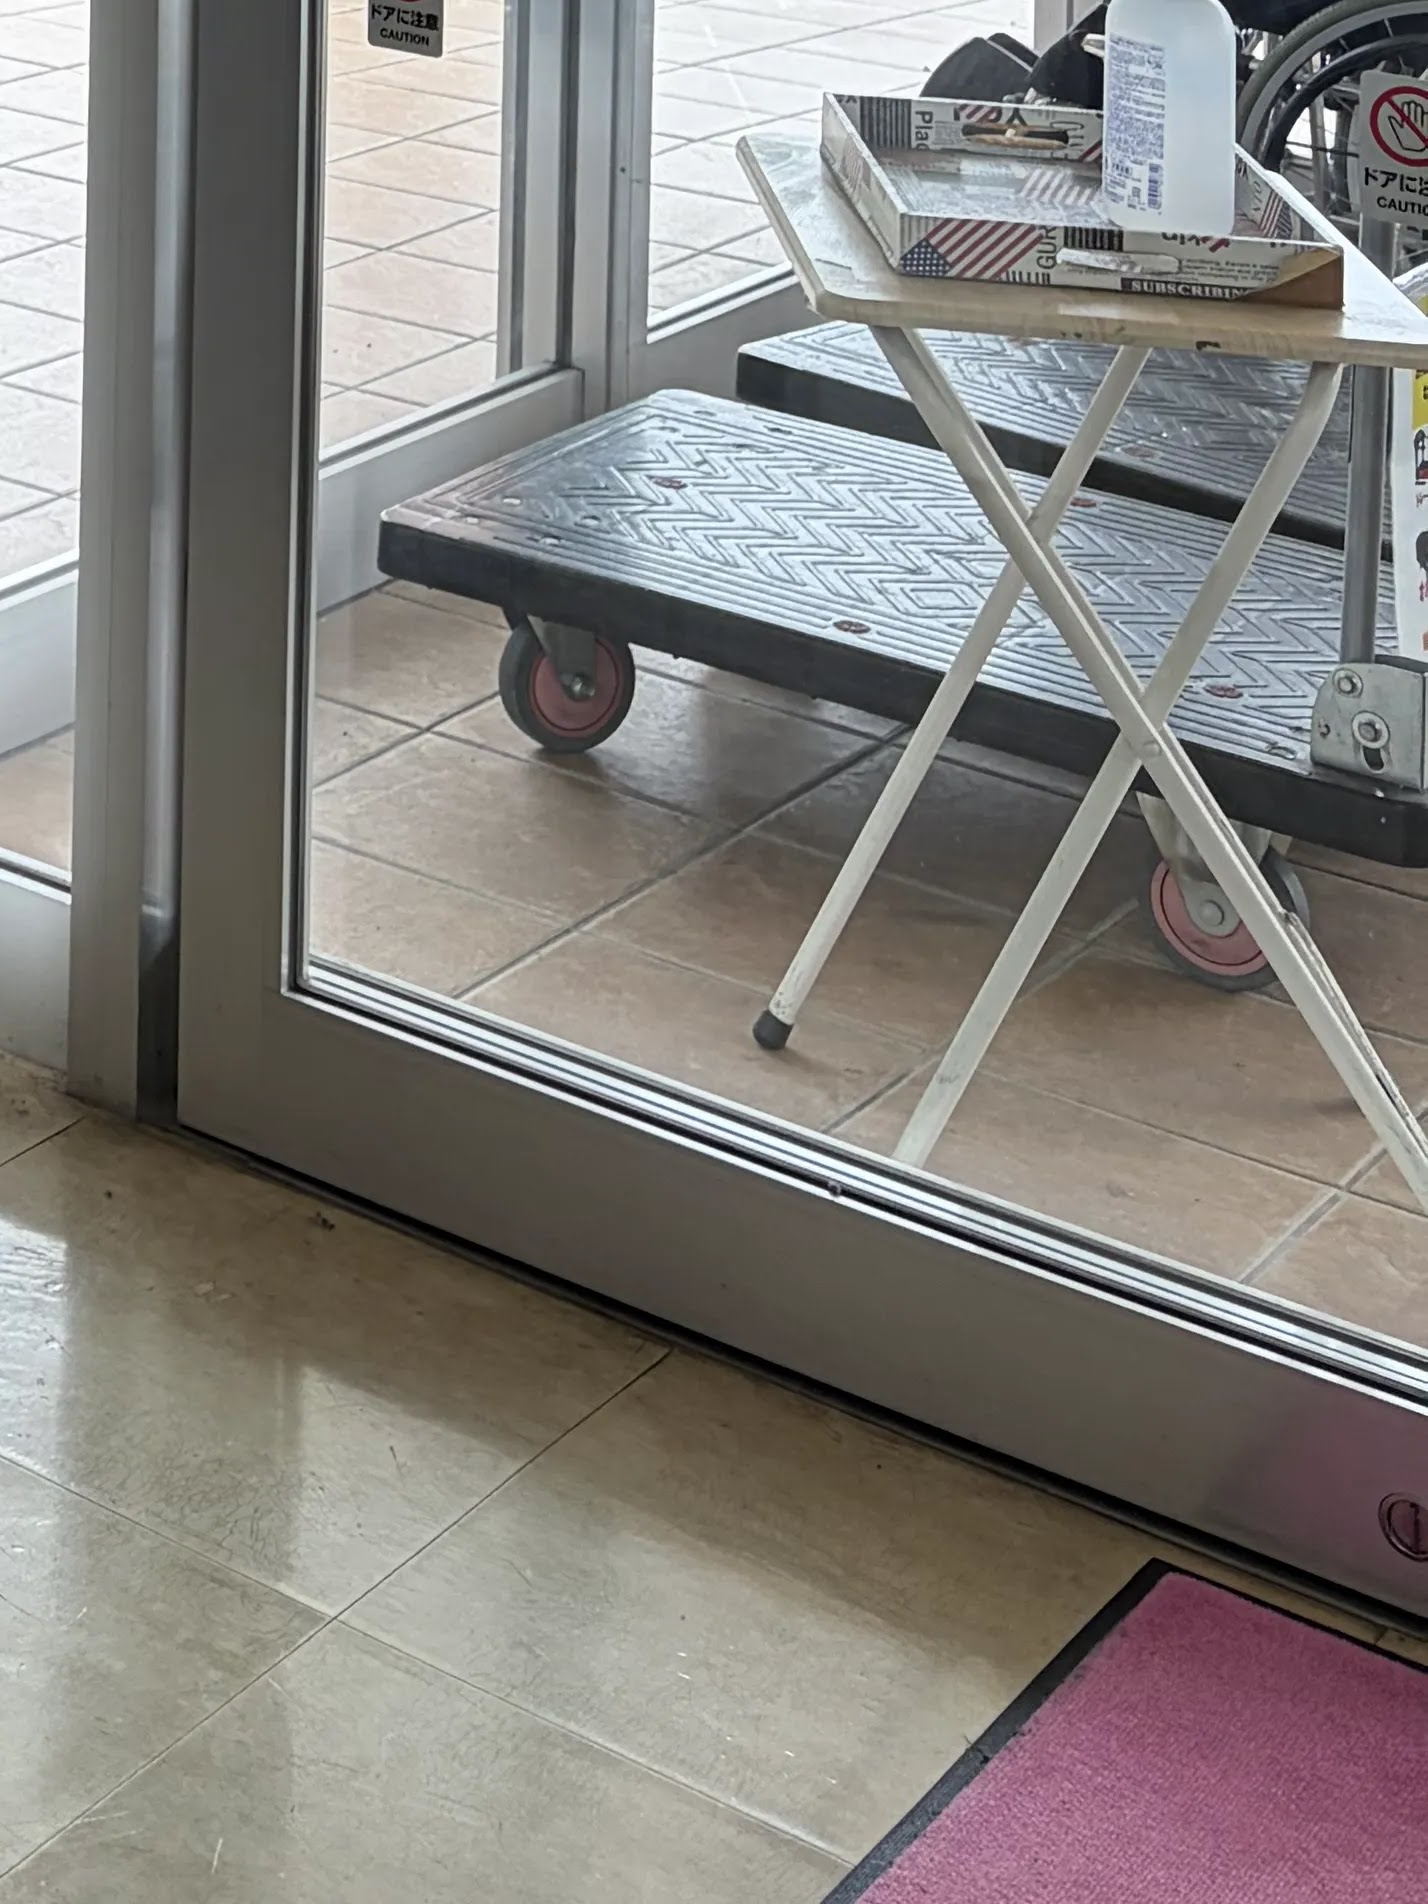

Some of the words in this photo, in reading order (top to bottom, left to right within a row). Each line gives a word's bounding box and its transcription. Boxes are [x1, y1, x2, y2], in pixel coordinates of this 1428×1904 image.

[371, 4, 439, 31] ドアに注意
[380, 28, 429, 47] CAUTION
